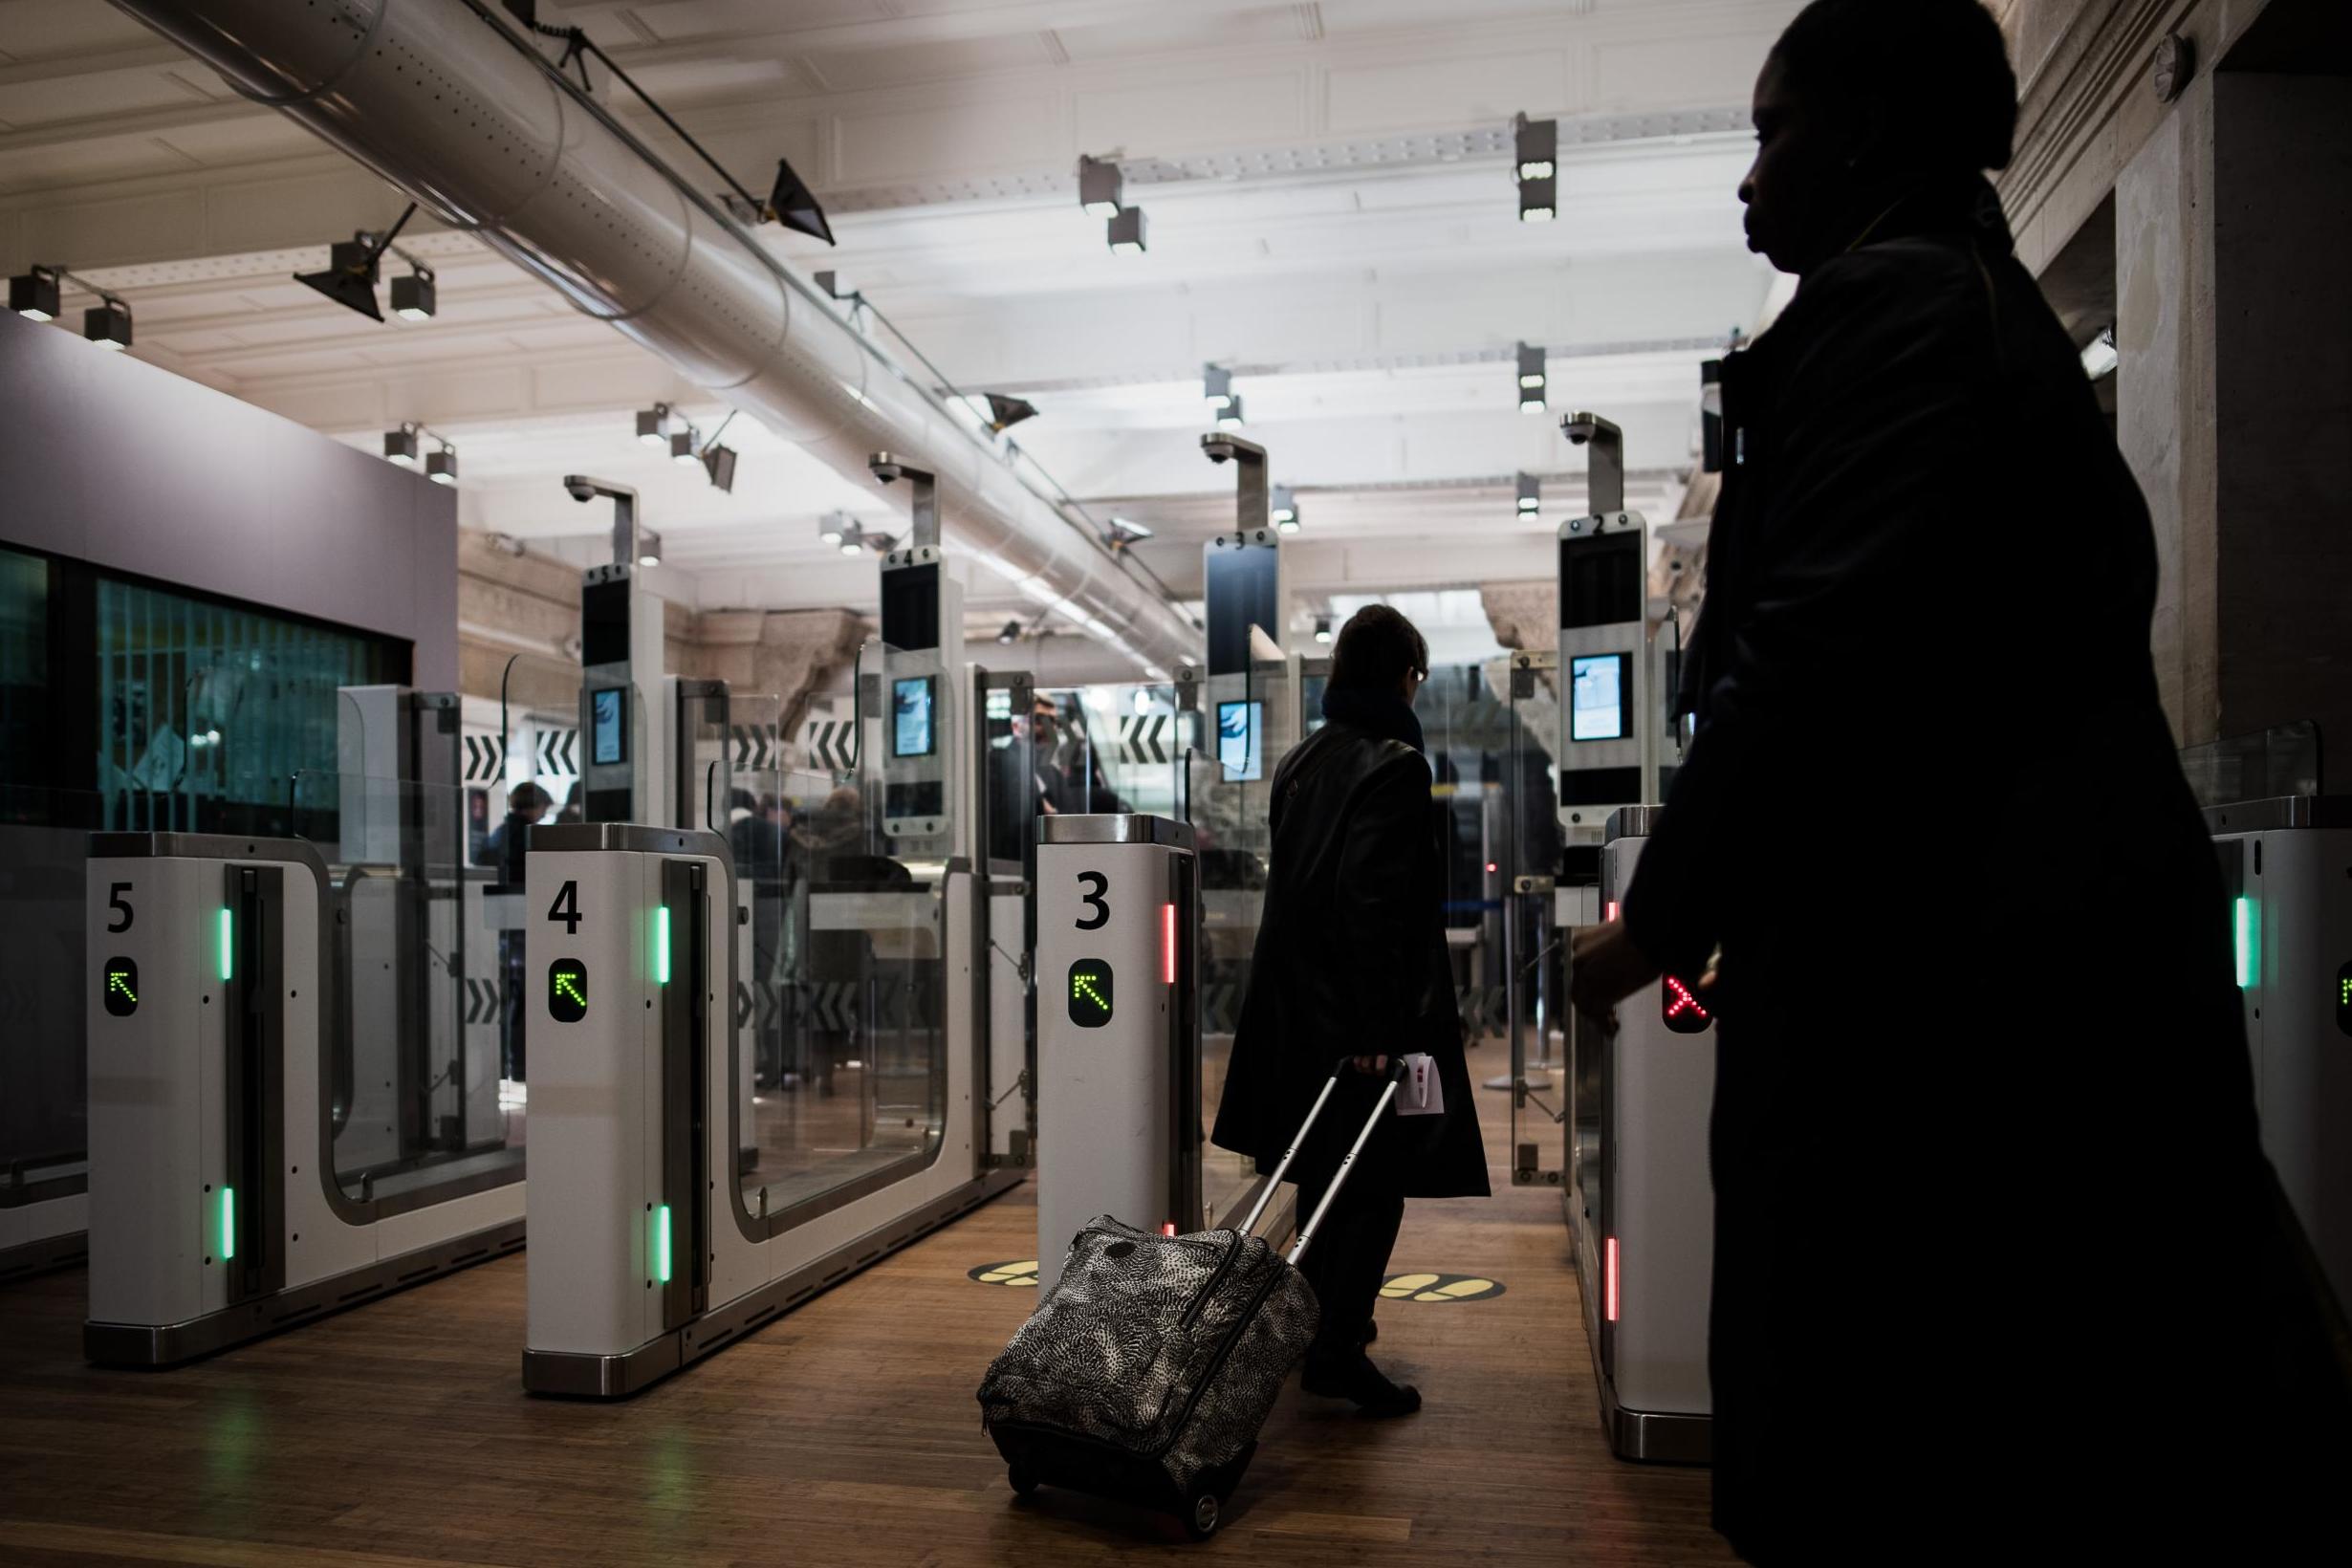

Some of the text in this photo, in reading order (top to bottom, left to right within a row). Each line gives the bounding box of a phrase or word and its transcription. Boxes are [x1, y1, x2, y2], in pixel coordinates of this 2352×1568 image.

[1593, 514, 1603, 535] 2
[1234, 532, 1245, 550] 3
[904, 550, 912, 566] 4
[601, 565, 609, 582] 5
[107, 882, 134, 934] 5
[548, 881, 582, 934] 4
[1075, 871, 1110, 929] 3
